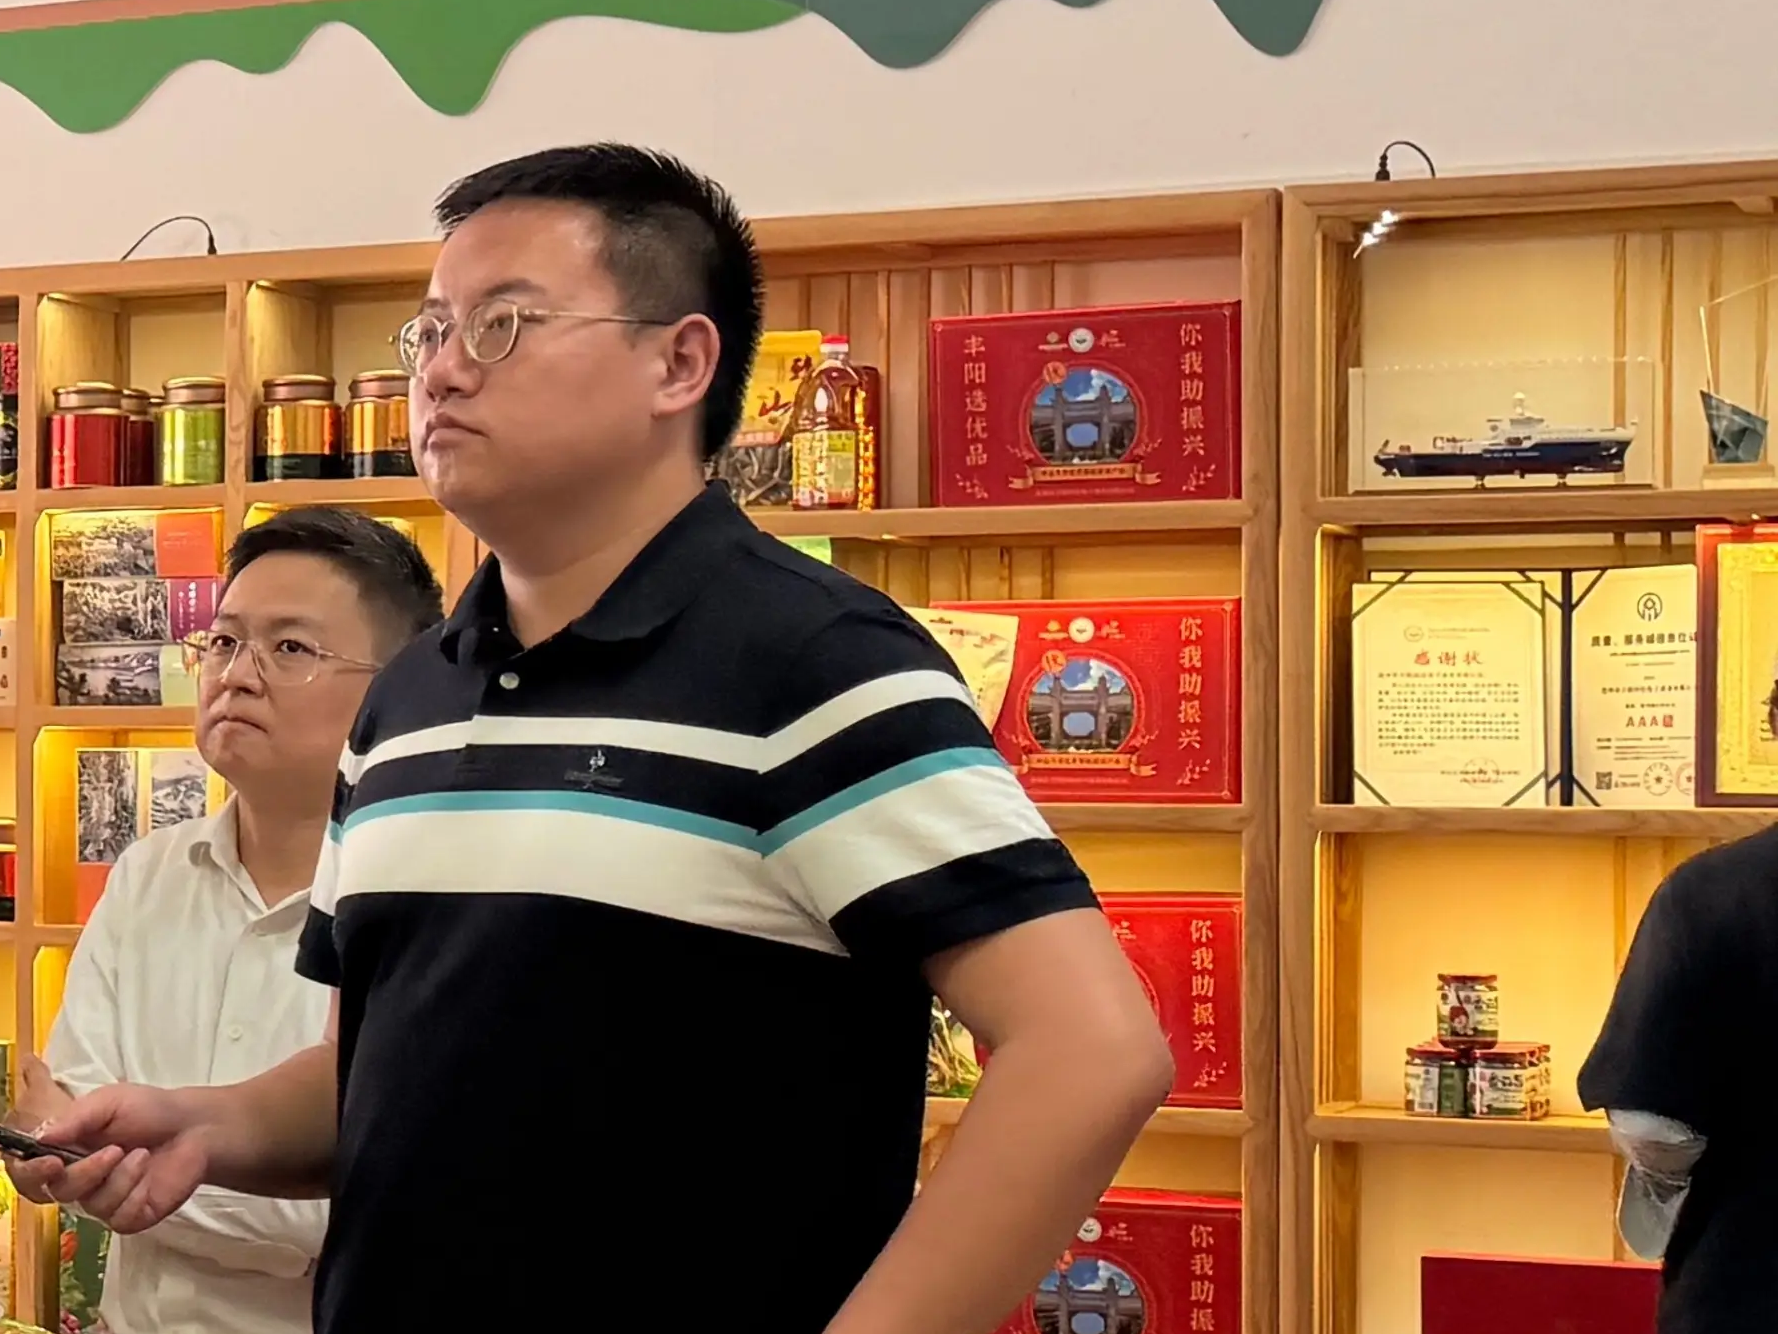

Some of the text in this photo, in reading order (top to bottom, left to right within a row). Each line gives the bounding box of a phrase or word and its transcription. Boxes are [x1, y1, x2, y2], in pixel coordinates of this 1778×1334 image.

[963, 335, 988, 466] 丰阳选优品
[1180, 323, 1205, 456] 你我助振兴
[1178, 616, 1203, 751] 你我助振兴
[1414, 649, 1483, 666] 感谢状
[1190, 919, 1217, 1053] 你我助振兴
